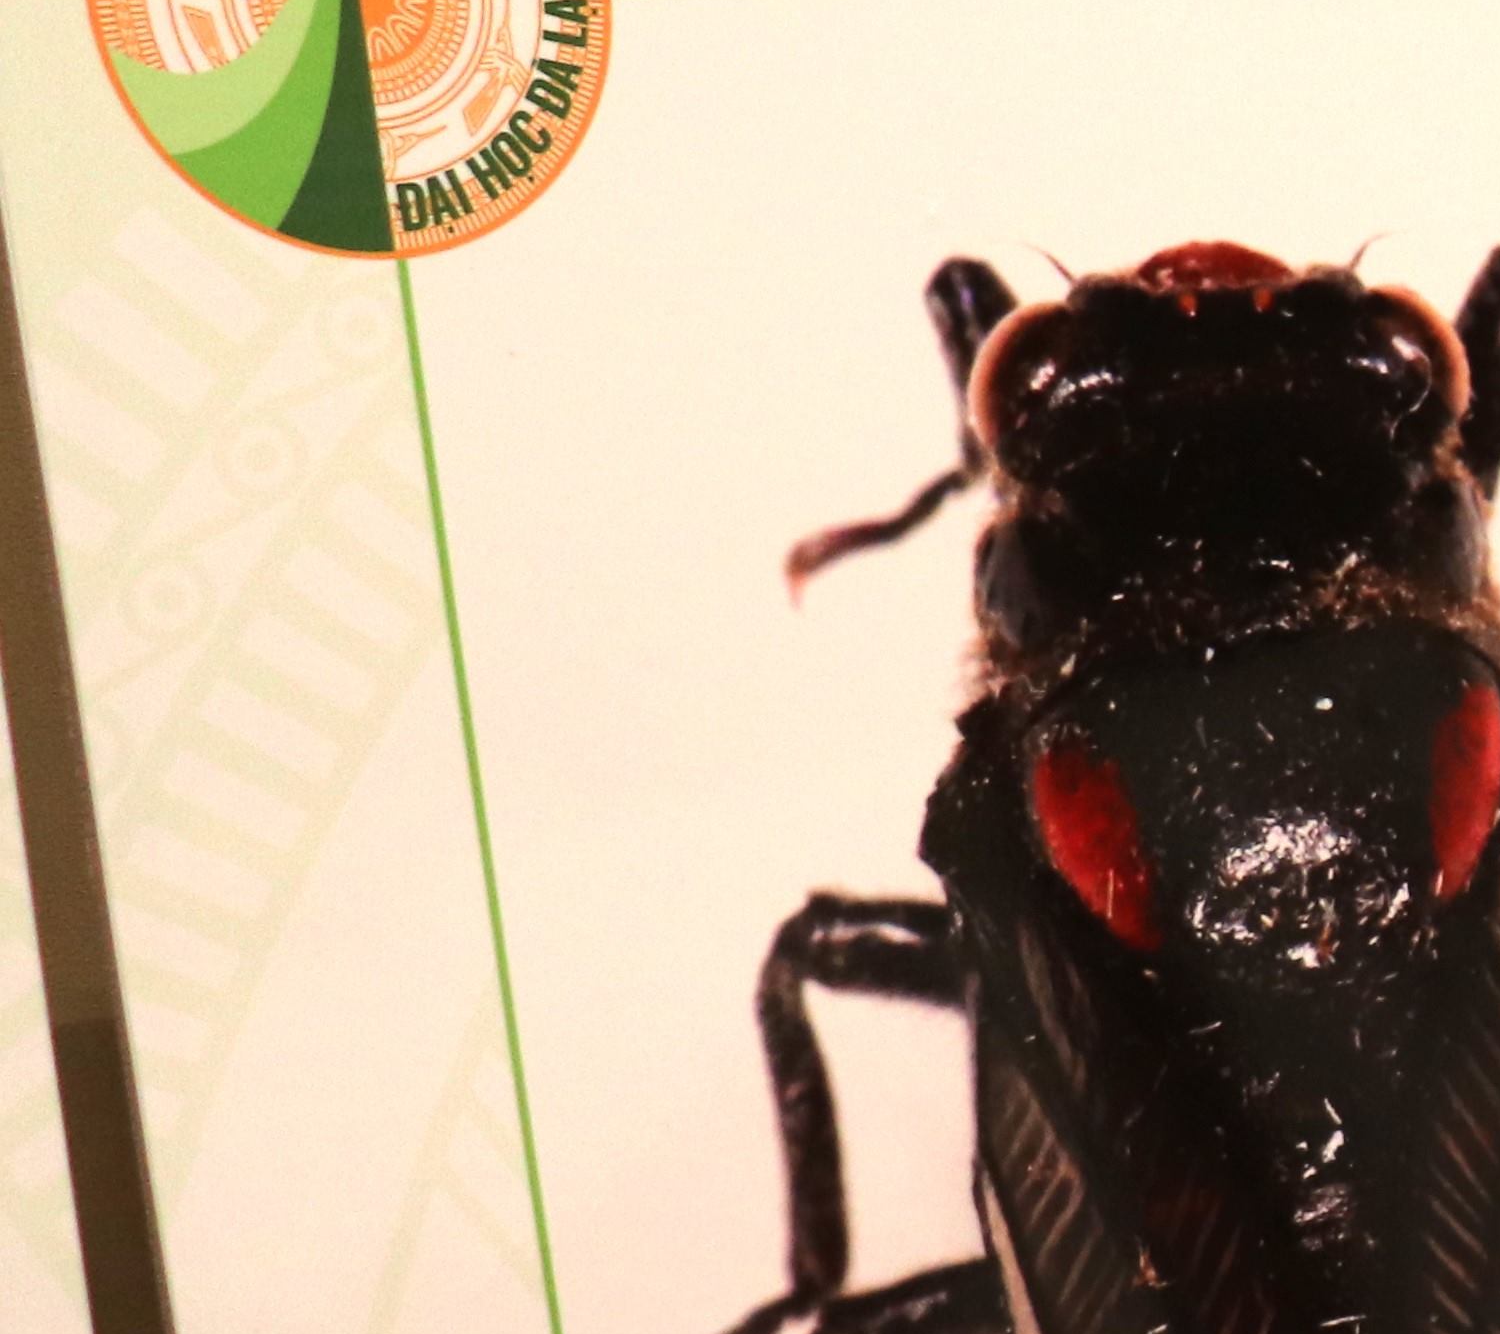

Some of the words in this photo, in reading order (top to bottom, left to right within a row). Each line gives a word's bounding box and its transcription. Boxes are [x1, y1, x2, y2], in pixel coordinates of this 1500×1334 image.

[396, 169, 475, 234] ĐẠI
[465, 110, 553, 200] HỌC
[525, 58, 582, 120] ĐÀ
